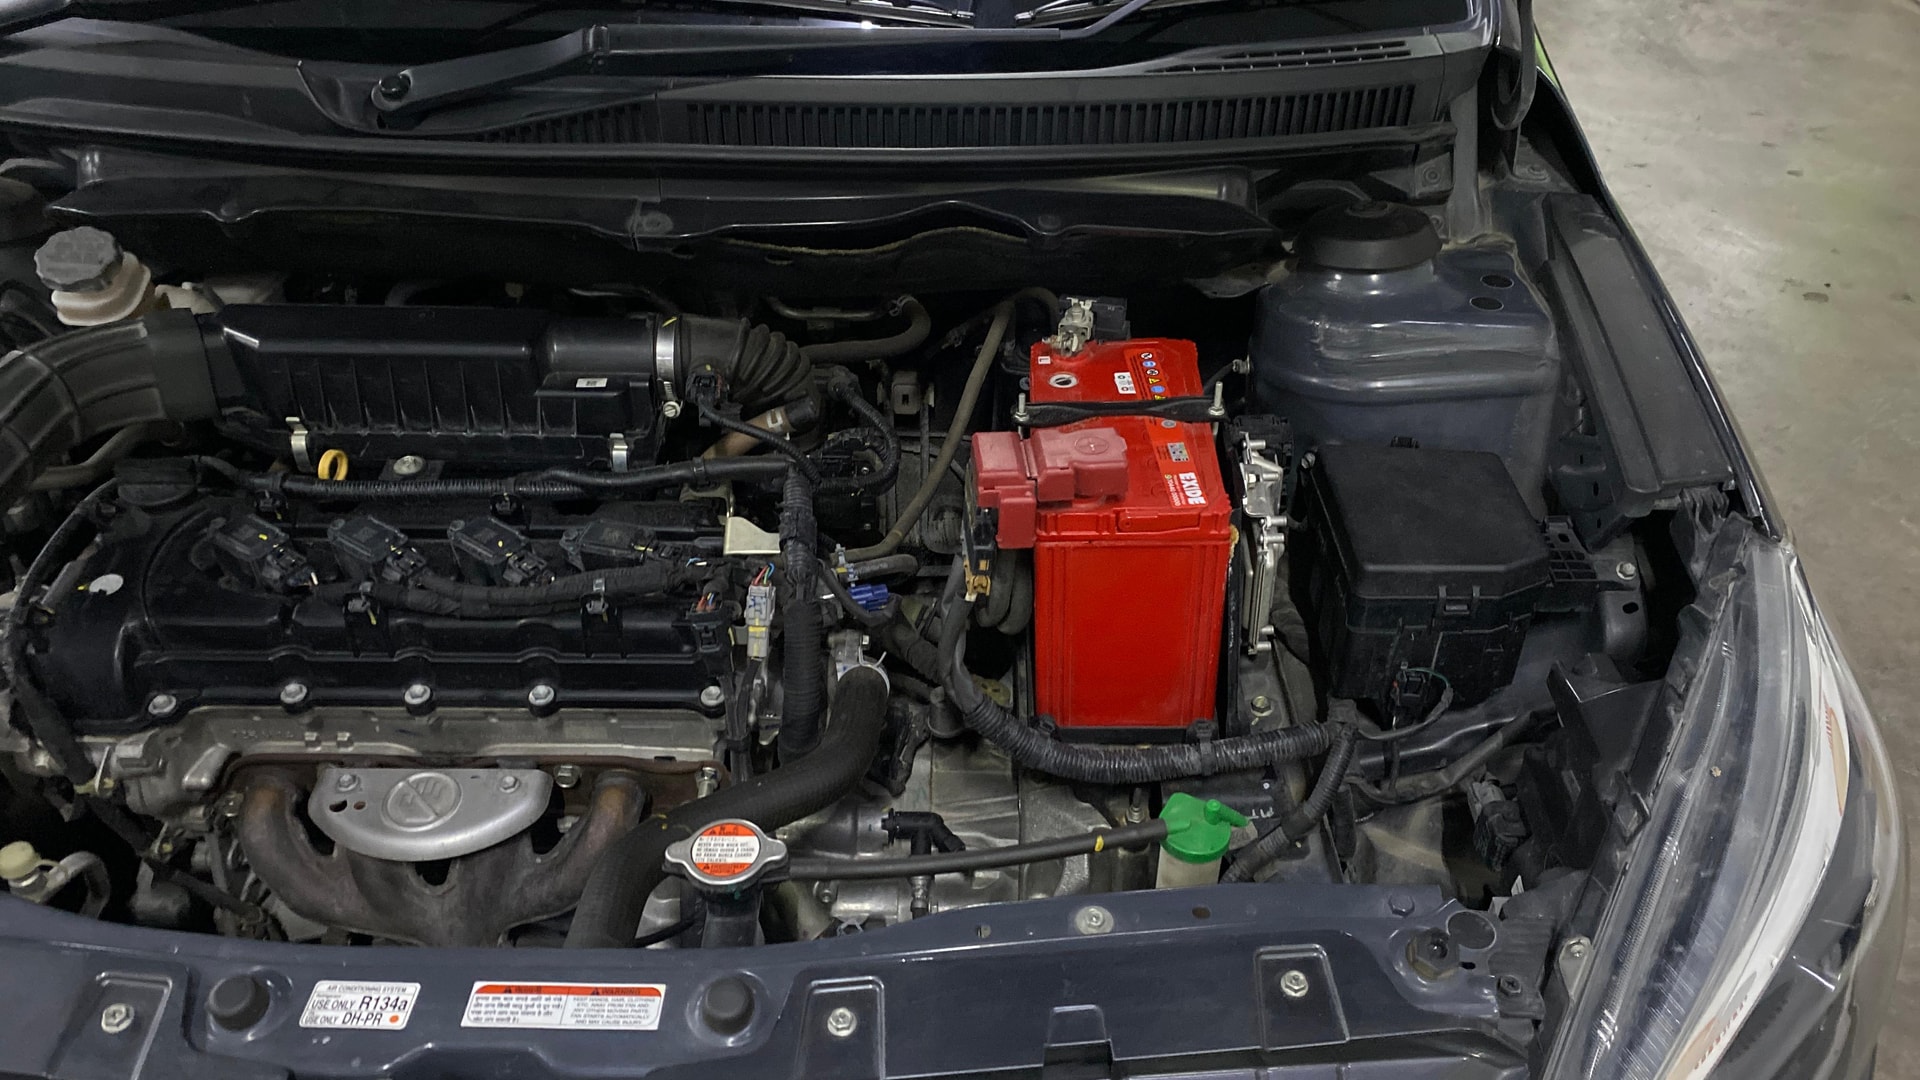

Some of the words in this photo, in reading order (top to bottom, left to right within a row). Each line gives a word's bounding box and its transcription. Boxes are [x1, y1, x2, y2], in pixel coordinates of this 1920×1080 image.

[1178, 472, 1207, 505] EXIDE
[311, 1000, 330, 1010] USE
[331, 1000, 356, 1010] ONLY
[358, 996, 408, 1011] R134a
[304, 1016, 318, 1025] USE
[318, 1016, 339, 1025] ONLY
[342, 1012, 383, 1026] DH-PR
